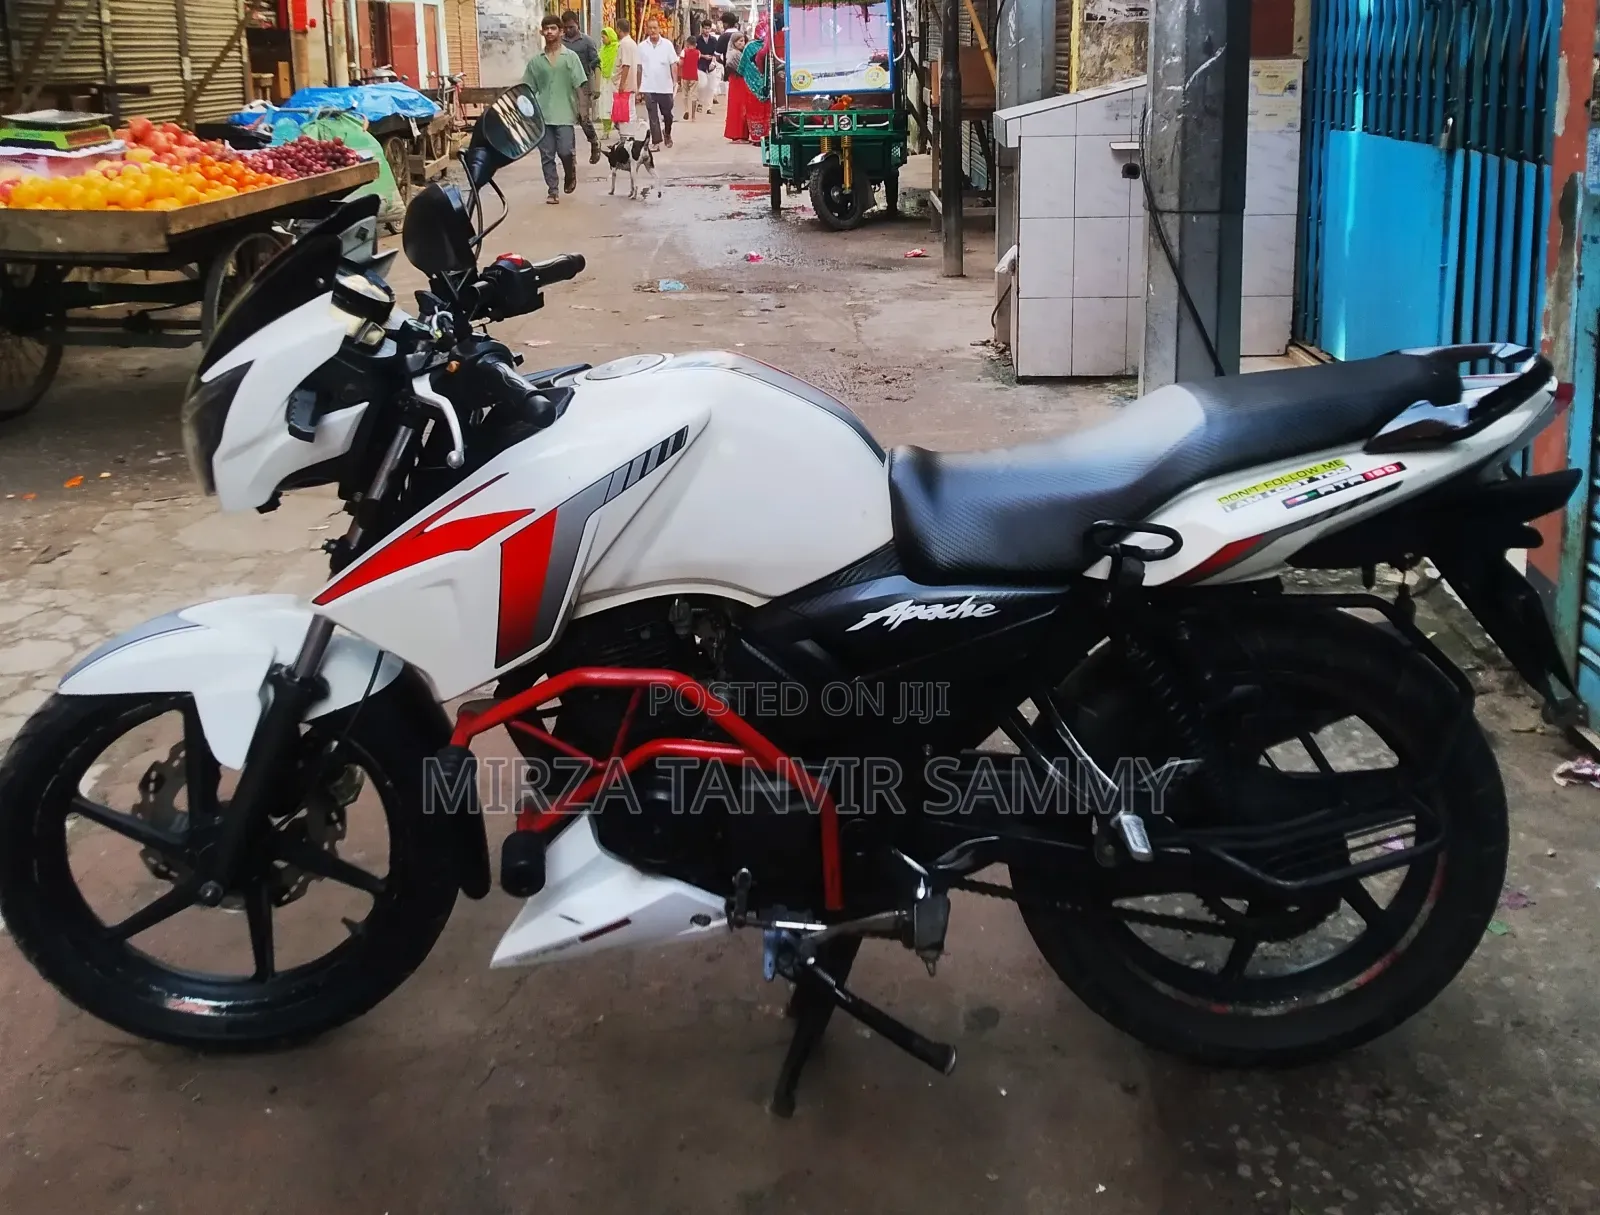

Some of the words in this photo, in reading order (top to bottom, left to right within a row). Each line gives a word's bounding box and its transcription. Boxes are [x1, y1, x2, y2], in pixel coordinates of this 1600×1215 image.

[1217, 485, 1259, 504] DON'T
[1263, 467, 1319, 488] FOLLOW
[1321, 459, 1343, 470] ME
[1235, 495, 1261, 507] AM
[1266, 478, 1309, 496] LOST
[1313, 465, 1351, 480] TOO
[1318, 474, 1366, 495] RTR
[845, 595, 1001, 632] Apache
